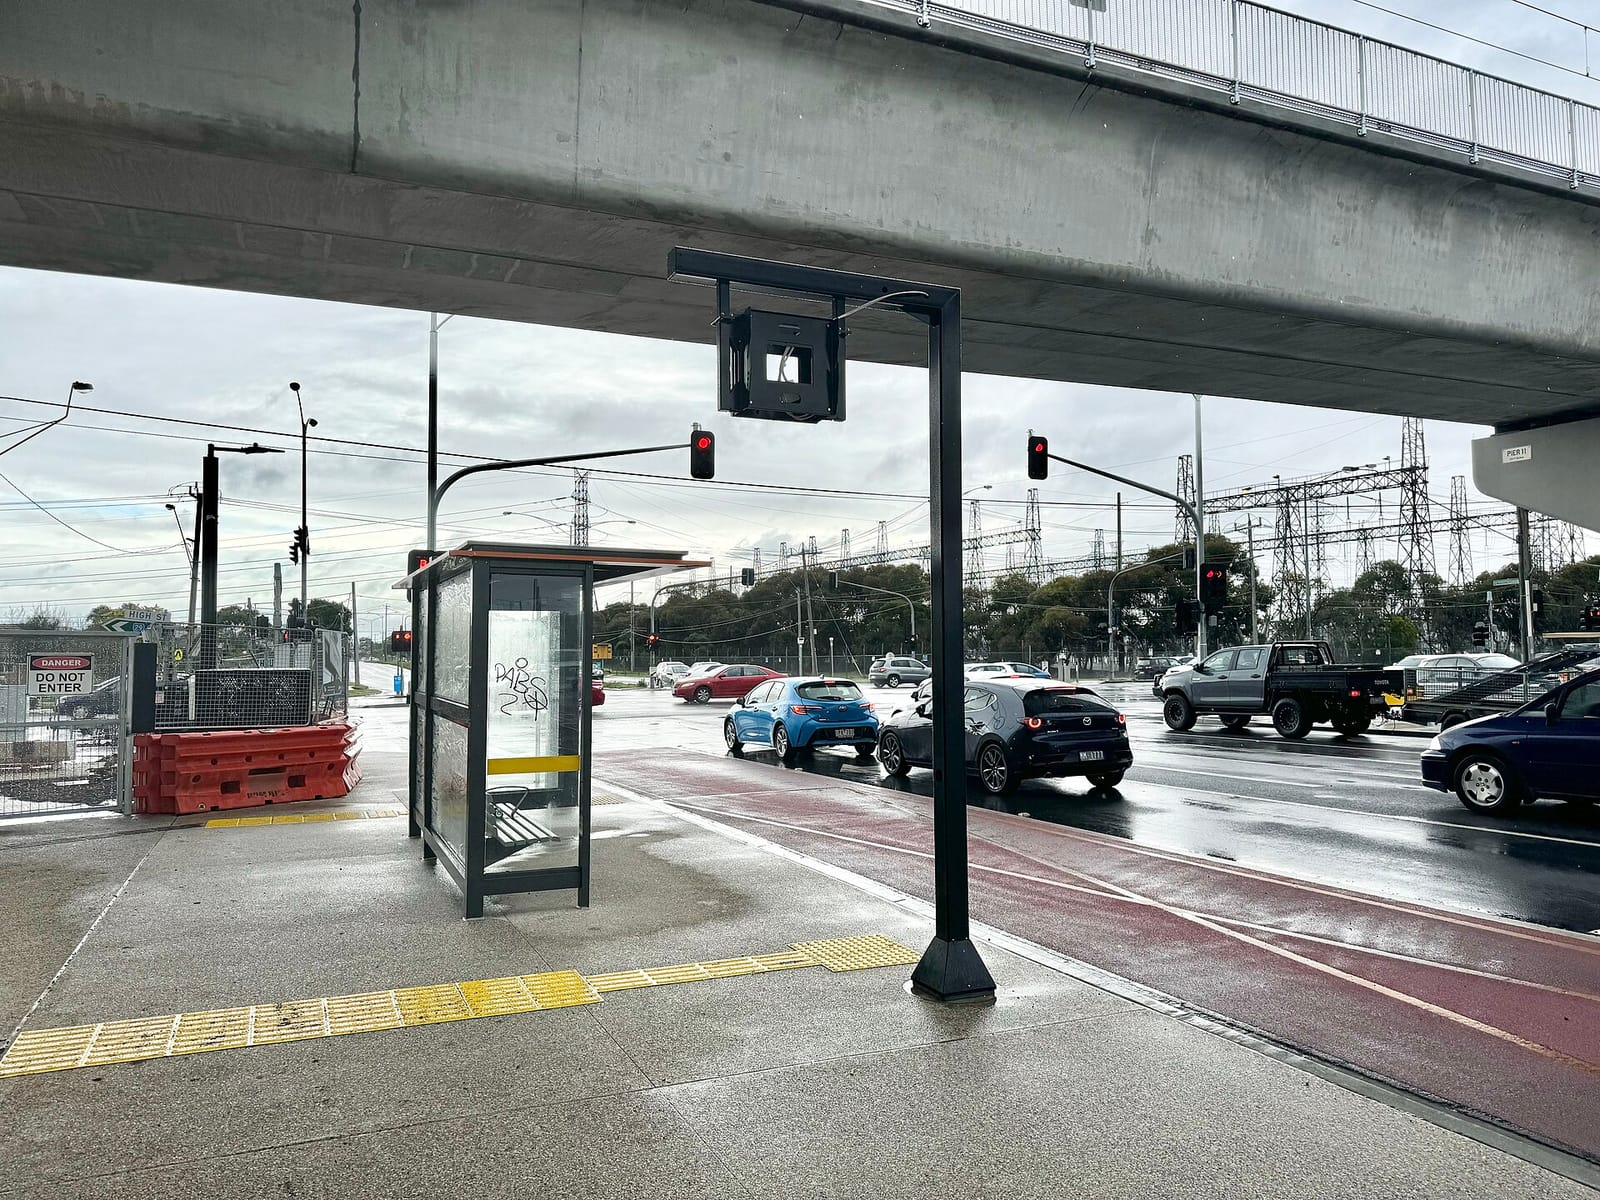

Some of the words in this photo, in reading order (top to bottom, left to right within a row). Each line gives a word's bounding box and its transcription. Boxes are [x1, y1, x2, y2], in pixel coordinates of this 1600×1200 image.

[1506, 449, 1521, 457] PIER
[1521, 447, 1527, 455] 11
[128, 610, 152, 620] HIGH
[156, 613, 168, 622] ST
[41, 659, 81, 667] DANGER
[36, 672, 55, 682] DO
[59, 672, 86, 682] NOT
[38, 683, 82, 693] ENTER
